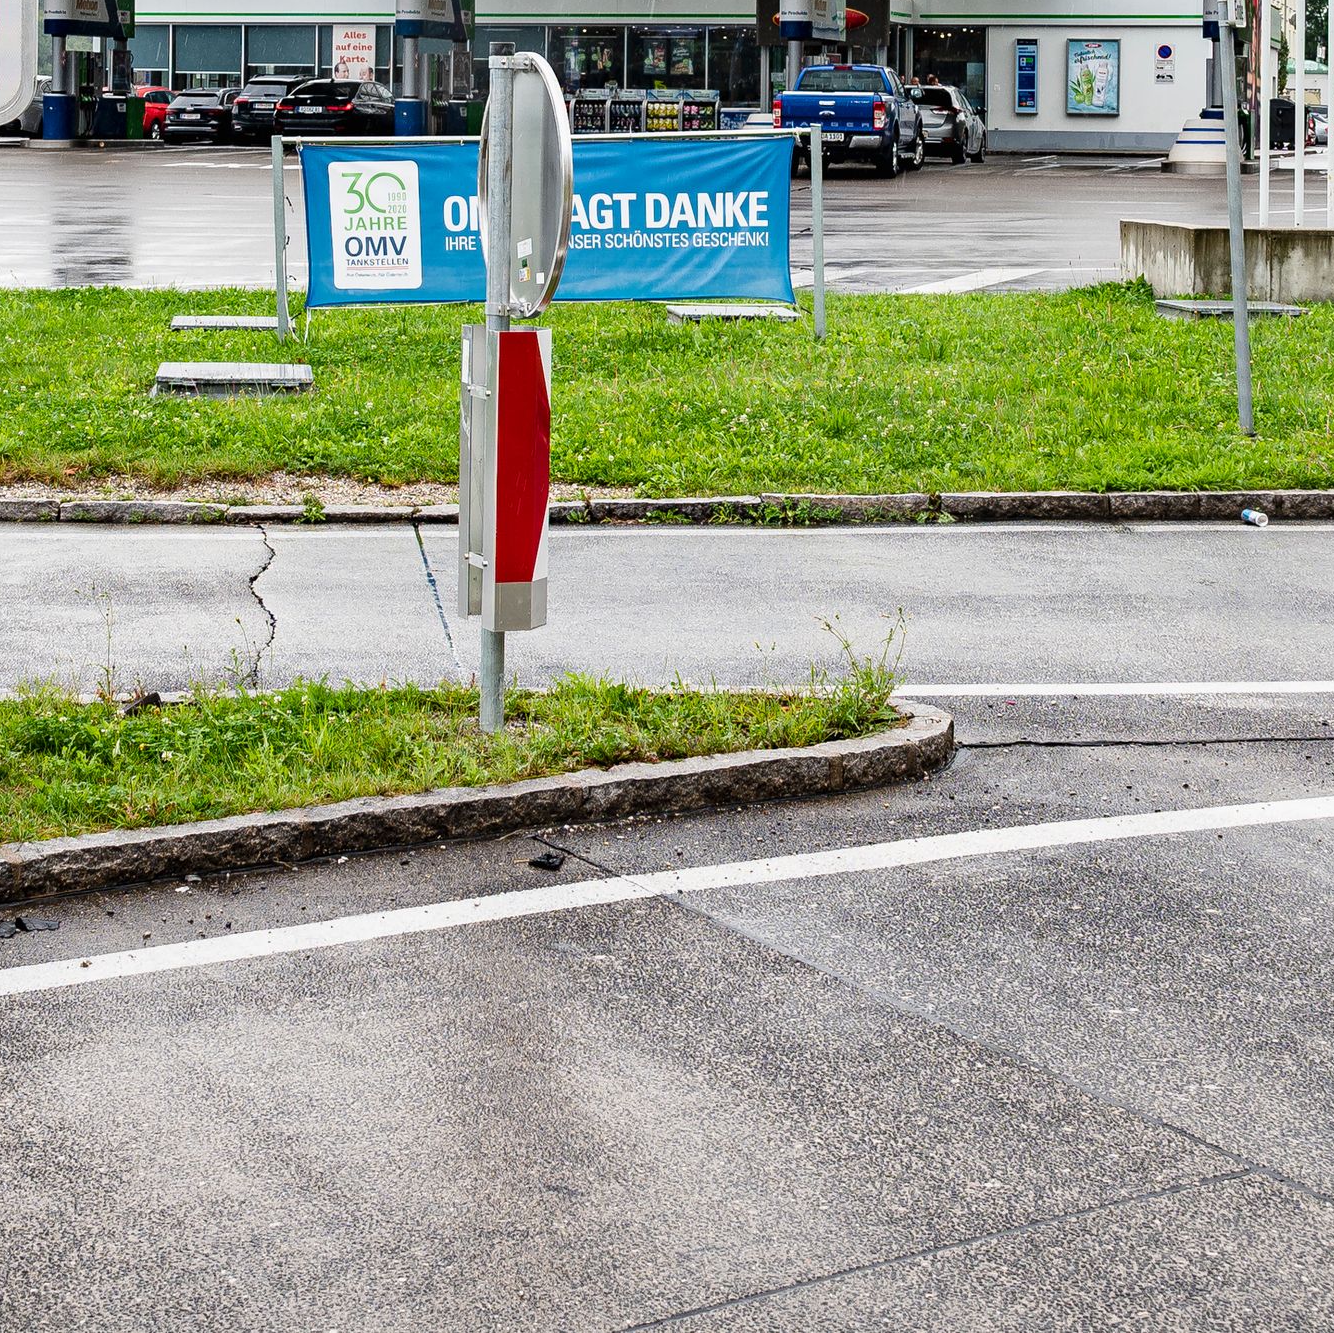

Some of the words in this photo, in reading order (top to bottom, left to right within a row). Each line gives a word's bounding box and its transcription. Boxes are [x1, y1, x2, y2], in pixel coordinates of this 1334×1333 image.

[336, 43, 351, 51] auf
[353, 43, 372, 51] eine
[388, 192, 407, 202] 1990
[388, 204, 407, 214] 2020
[570, 192, 637, 230] AGT
[646, 191, 769, 229] DANKE
[344, 216, 408, 231] JAHRE
[345, 236, 407, 257] OMV
[445, 236, 476, 251] IHRE
[568, 234, 601, 249] NSER
[605, 230, 689, 248] SCHÖNSTES
[692, 232, 769, 248] GESCHENK!
[346, 258, 409, 267] TANKSTELLEN
